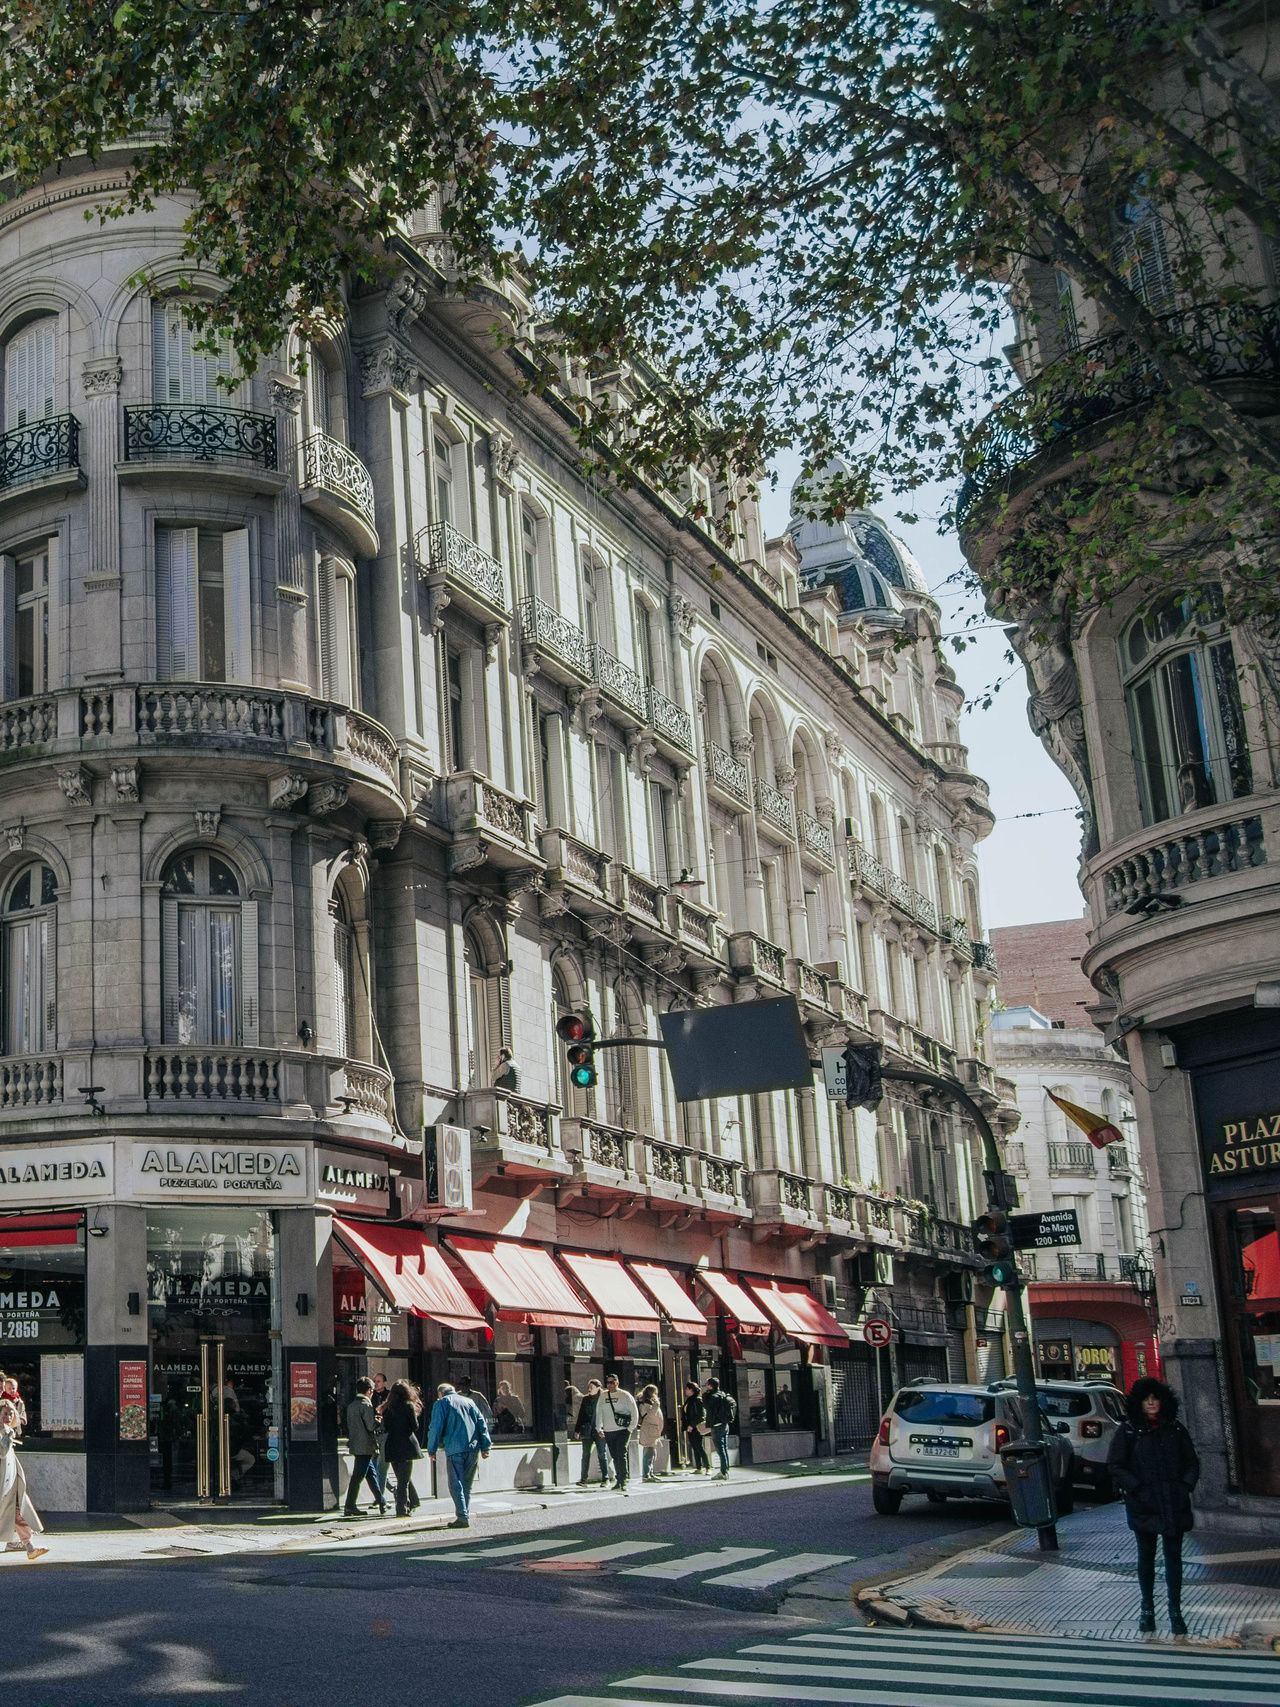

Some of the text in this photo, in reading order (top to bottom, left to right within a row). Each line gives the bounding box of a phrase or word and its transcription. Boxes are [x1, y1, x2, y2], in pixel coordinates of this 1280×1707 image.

[141, 1150, 300, 1175] ALAMEDA
[160, 1176, 282, 1190] PIZZERIA PORTEÑA
[322, 1165, 390, 1192] ALAMEDA
[1041, 1212, 1073, 1223] Avenida
[1039, 1224, 1074, 1234] De Mayo
[1034, 1237, 1052, 1245] 1200
[1059, 1234, 1076, 1243] 1100
[1082, 1348, 1108, 1365] ORO
